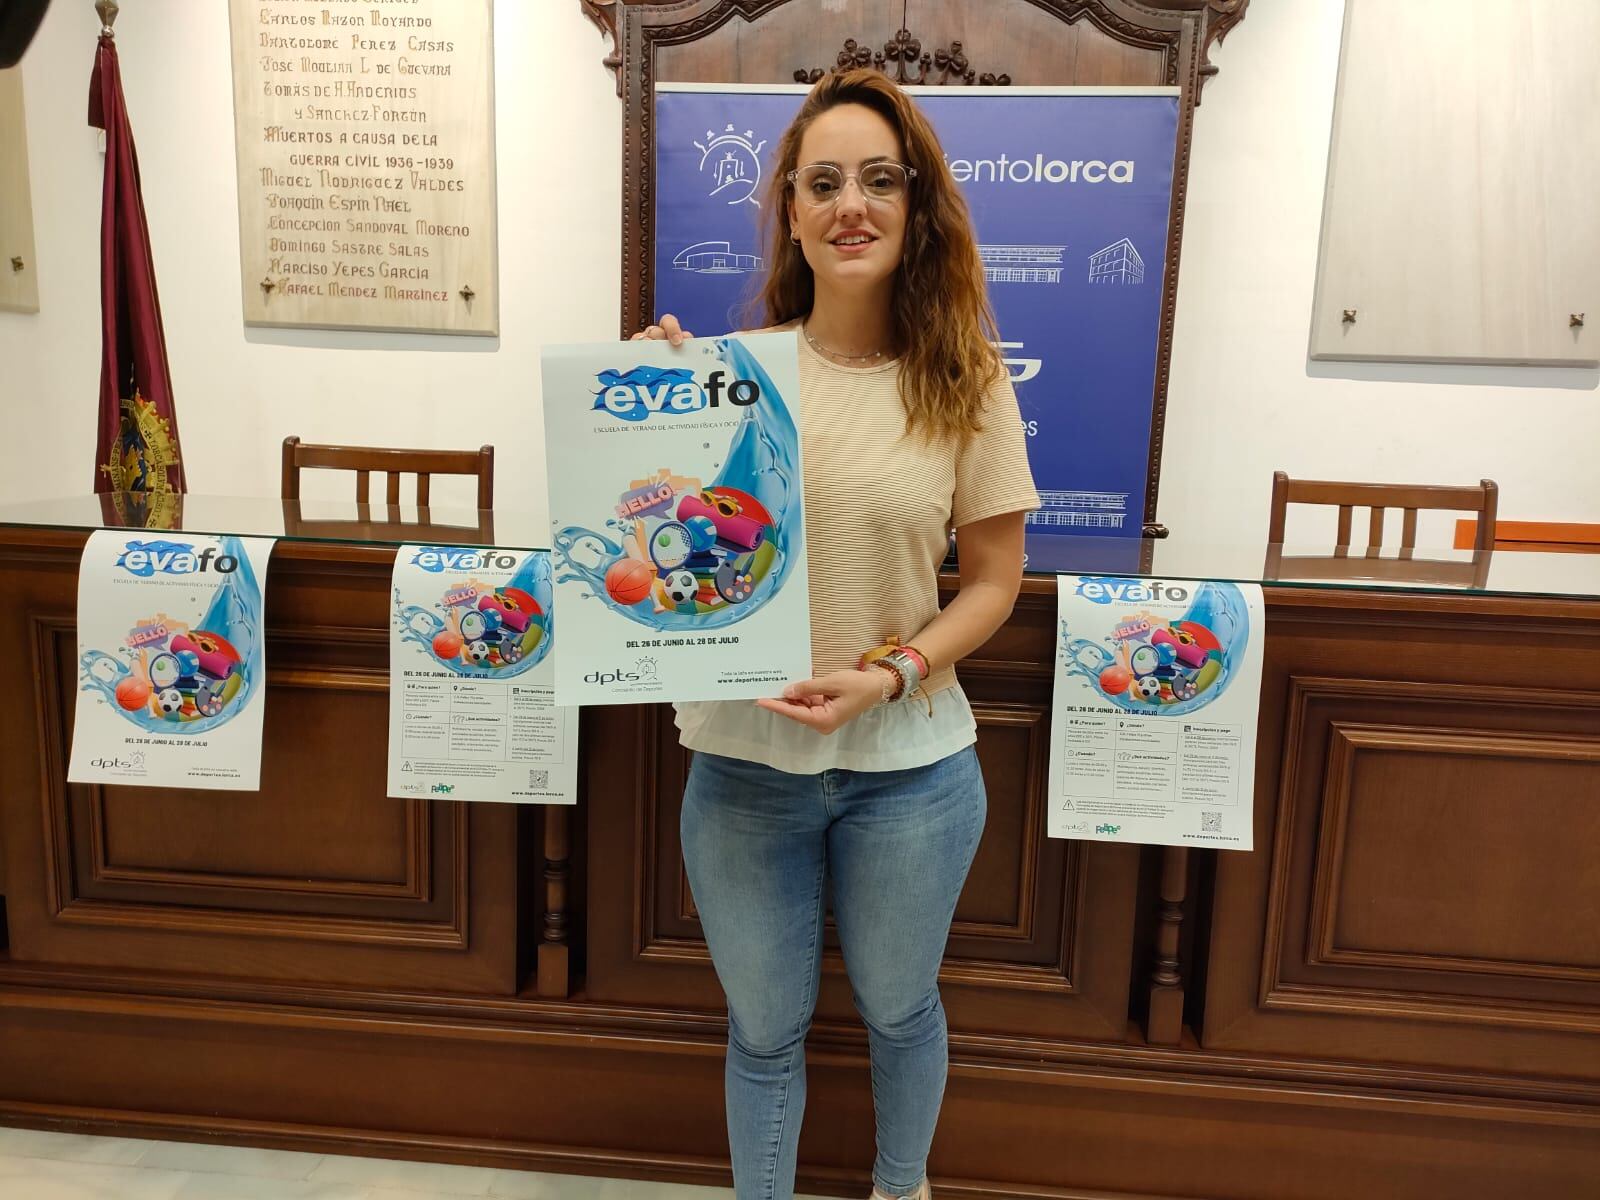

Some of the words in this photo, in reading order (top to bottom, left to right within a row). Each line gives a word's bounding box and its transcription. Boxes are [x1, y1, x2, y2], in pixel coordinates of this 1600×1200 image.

[408, 35, 454, 53] CASAS
[376, 64, 391, 74] DE
[314, 86, 331, 97] DE
[263, 126, 333, 144] MUERTOS
[339, 132, 348, 144] A
[352, 133, 396, 146] CAUSA
[289, 154, 340, 168] GUERRA
[345, 154, 381, 168] CIVIL
[347, 219, 409, 235] SANDOVAL
[416, 220, 470, 237] MORENO
[270, 237, 326, 254] DOMINGO
[331, 240, 385, 256] SASTRE
[388, 242, 430, 258] SALAS
[332, 261, 376, 278] YEPES
[328, 282, 379, 298] MENDEZ
[604, 370, 760, 413] evafo
[632, 425, 657, 433] VERANO
[124, 548, 239, 573] evafo
[417, 550, 516, 570] evafo
[1081, 581, 1188, 602] evafo
[626, 640, 640, 649] DEL
[642, 640, 651, 648] 26
[652, 639, 661, 648] DE
[662, 638, 684, 648] JUNIO
[686, 638, 695, 647] AL
[697, 637, 706, 646] 28
[708, 637, 717, 645] DE
[718, 636, 739, 645] JULIO
[584, 668, 640, 686] dpts
[717, 676, 788, 684] www.deportes.lorca.es
[91, 757, 131, 769] dpts
